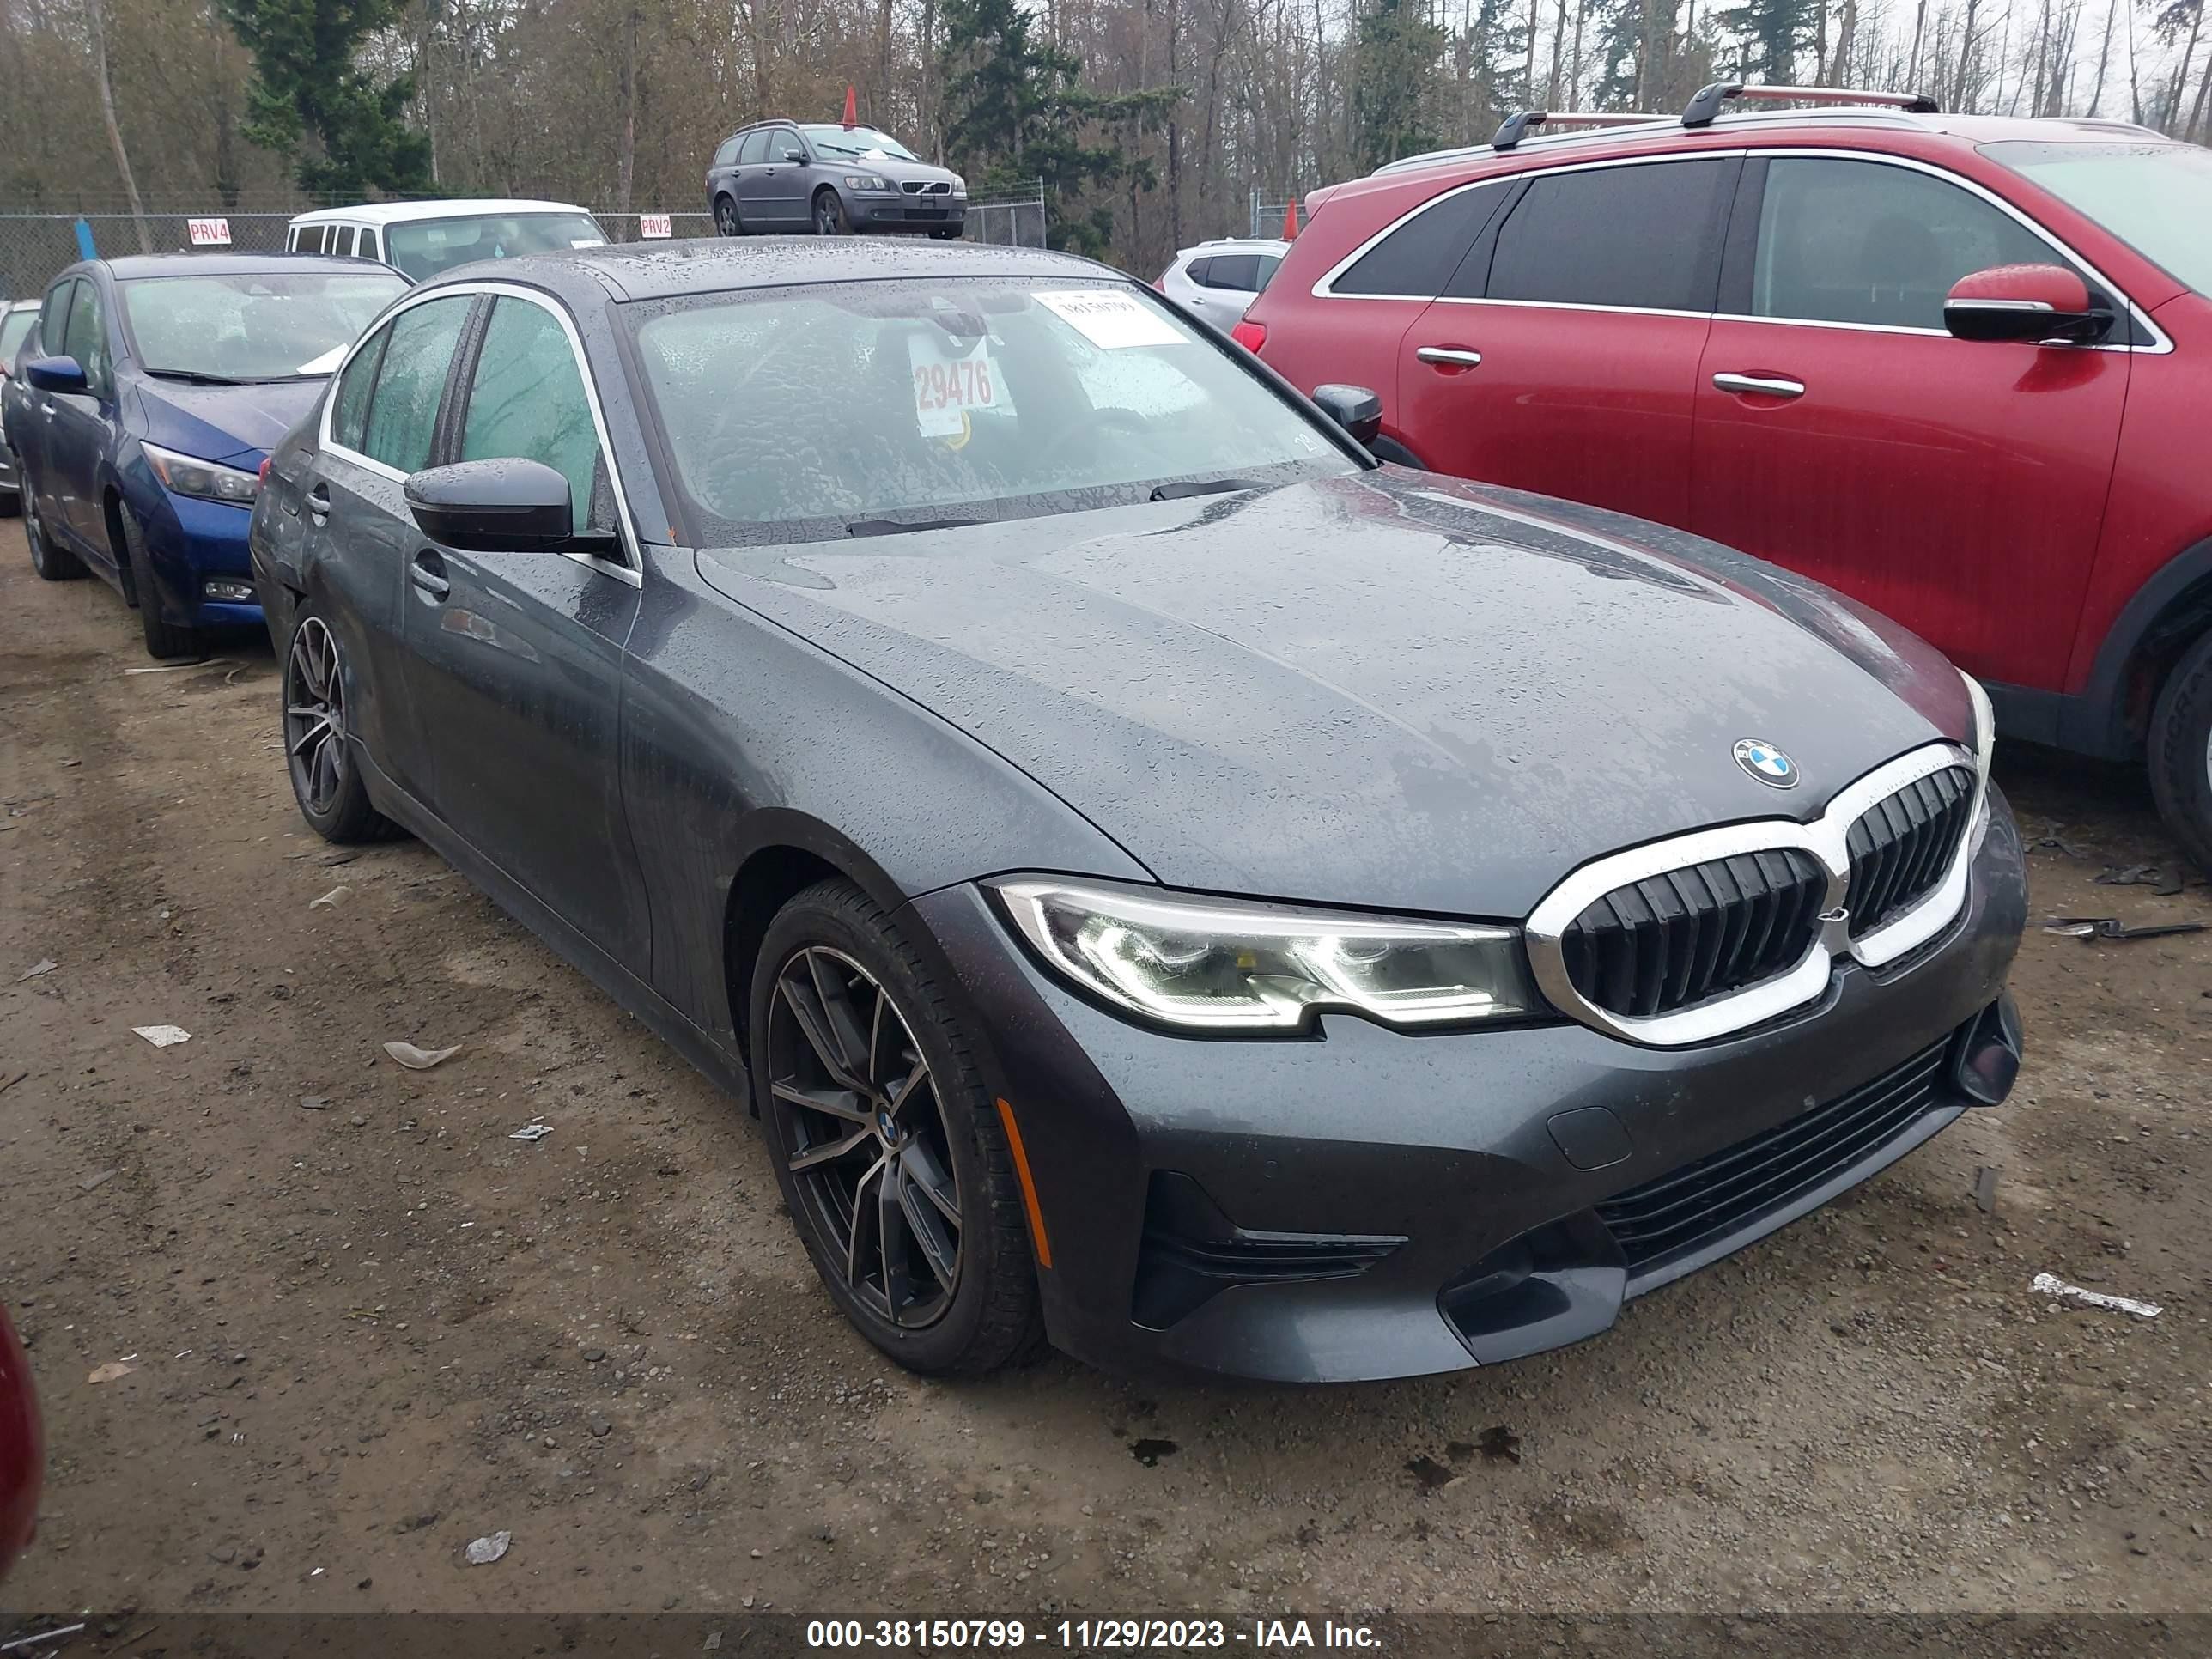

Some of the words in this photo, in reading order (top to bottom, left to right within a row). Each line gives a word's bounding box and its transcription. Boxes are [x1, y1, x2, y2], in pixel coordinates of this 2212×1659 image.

[191, 223, 230, 240] PRV4
[641, 219, 671, 234] PRV2
[915, 360, 992, 410] 29476
